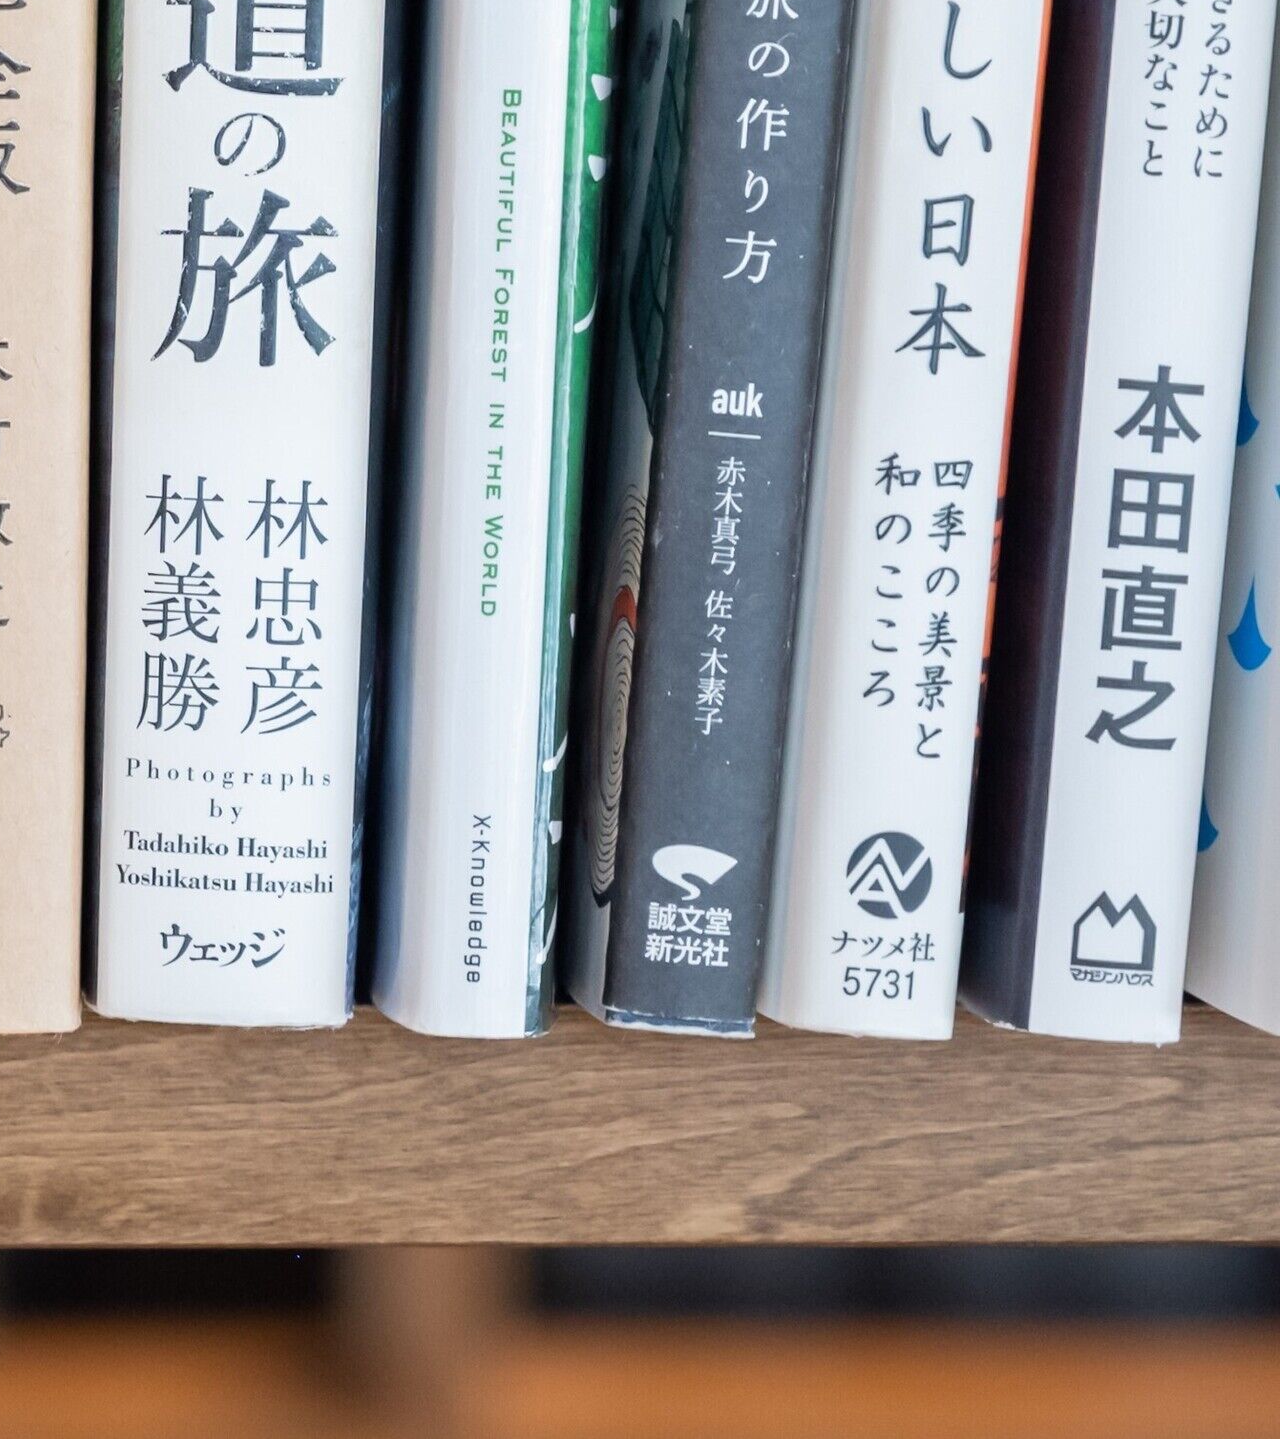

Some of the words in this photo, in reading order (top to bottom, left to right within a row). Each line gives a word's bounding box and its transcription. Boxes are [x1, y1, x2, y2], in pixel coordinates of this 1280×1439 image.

[493, 89, 523, 251] BEAUTIFUL
[490, 268, 515, 382] FOREST
[487, 403, 506, 429] IN
[712, 383, 764, 419] auk
[485, 446, 504, 500] THE
[480, 515, 504, 618] WORLD
[861, 452, 922, 708] 和のこころ
[1084, 364, 1206, 752] 本田直之
[136, 474, 226, 732] 林義勝
[239, 478, 330, 736] 林忠彦
[914, 458, 974, 760] 四季の美景と
[126, 758, 332, 795] Photographs
[209, 798, 244, 824] by
[123, 829, 230, 858] Tadahiko
[236, 836, 329, 863] Hayashi
[115, 865, 238, 894] Yoshikatsu
[243, 872, 335, 900] Hayashi
[464, 814, 492, 984] X-Knowledge
[647, 902, 733, 937] 誠文堂
[159, 923, 286, 968] ウェッジ
[644, 935, 730, 968] 新光社
[831, 930, 936, 963] ナツメ社
[842, 966, 916, 1000] 5731
